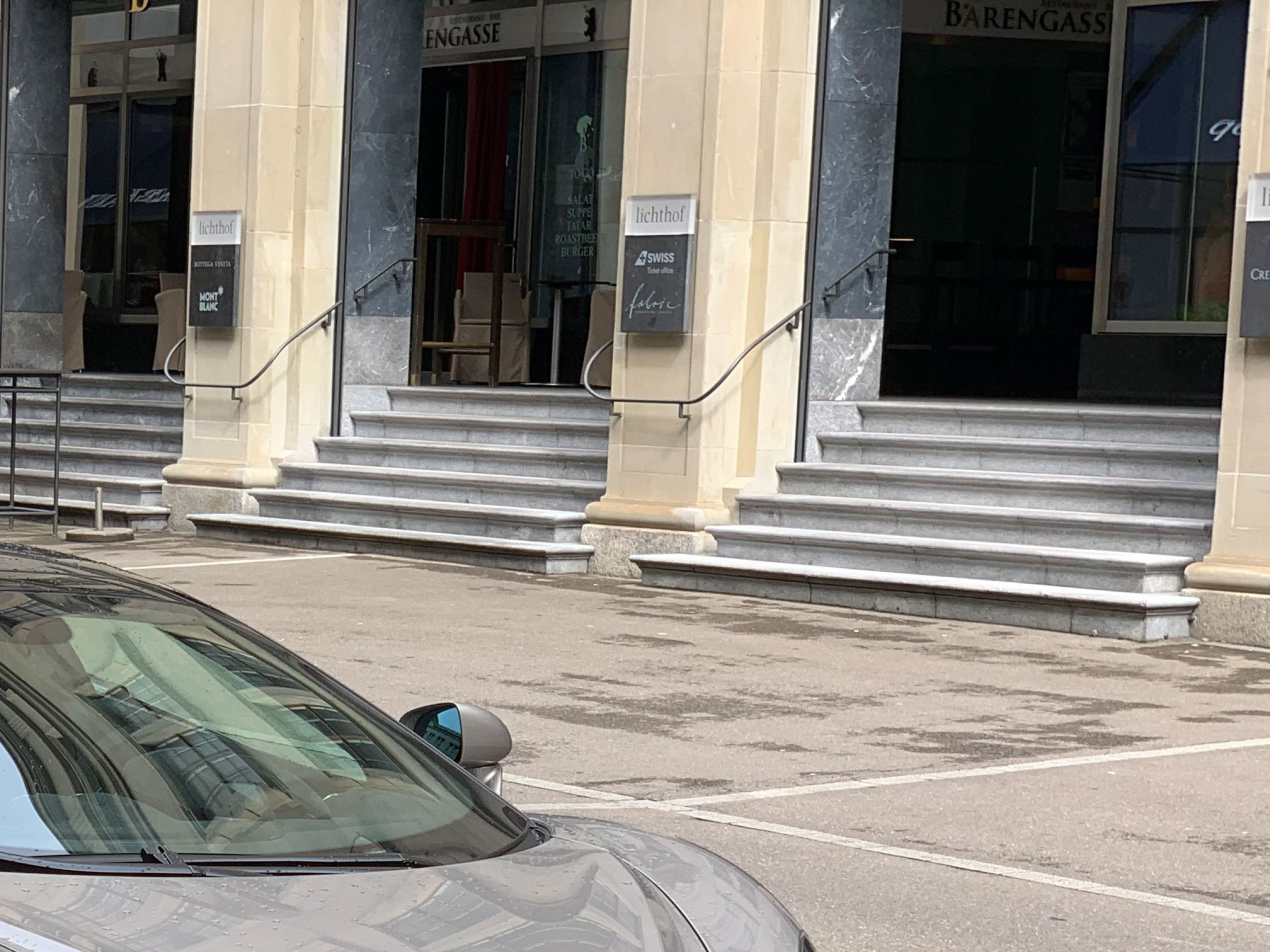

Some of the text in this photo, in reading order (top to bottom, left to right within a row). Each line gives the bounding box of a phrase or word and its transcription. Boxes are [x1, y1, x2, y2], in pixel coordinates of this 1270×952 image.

[423, 22, 501, 49] ENGASSE
[567, 193, 594, 205] SALAT
[567, 207, 593, 218] SUPPE
[635, 205, 686, 224] lichthof
[199, 220, 234, 235] lichthof
[566, 220, 592, 231] TATAR
[560, 246, 595, 258] BURGER
[647, 252, 675, 263] SWISS
[214, 260, 232, 268] VENETA
[646, 266, 674, 275] Ticket office
[199, 291, 218, 302] MONT
[199, 302, 218, 312] BLANC
